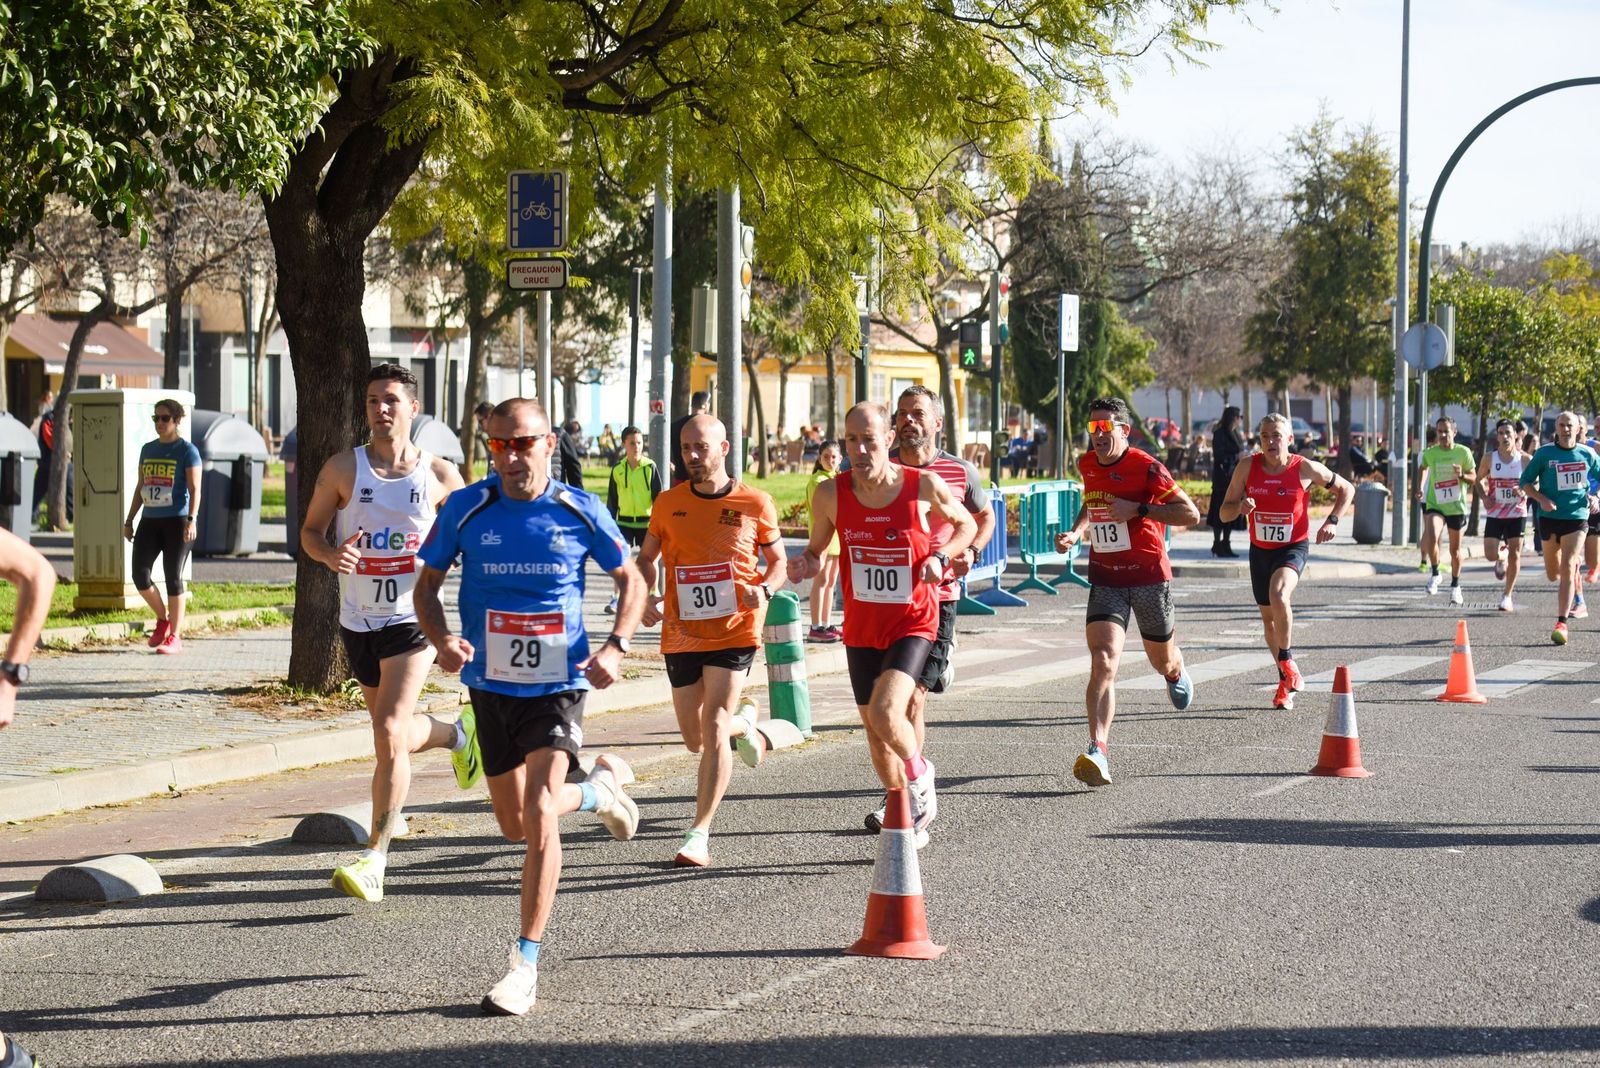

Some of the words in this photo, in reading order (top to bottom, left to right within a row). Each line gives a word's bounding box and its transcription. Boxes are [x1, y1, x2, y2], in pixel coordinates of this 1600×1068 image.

[511, 265, 561, 274] PRECAUCIÓN
[523, 276, 550, 284] CRUCE
[1564, 472, 1582, 485] 110
[150, 486, 161, 501] 12
[1442, 488, 1453, 499] 71
[1093, 524, 1118, 543] 113
[1262, 526, 1285, 541] 175
[482, 562, 569, 575] TROTASIERRA
[864, 567, 898, 592] 100
[372, 578, 398, 603] 70
[692, 585, 717, 609] 30
[510, 638, 542, 669] 29
